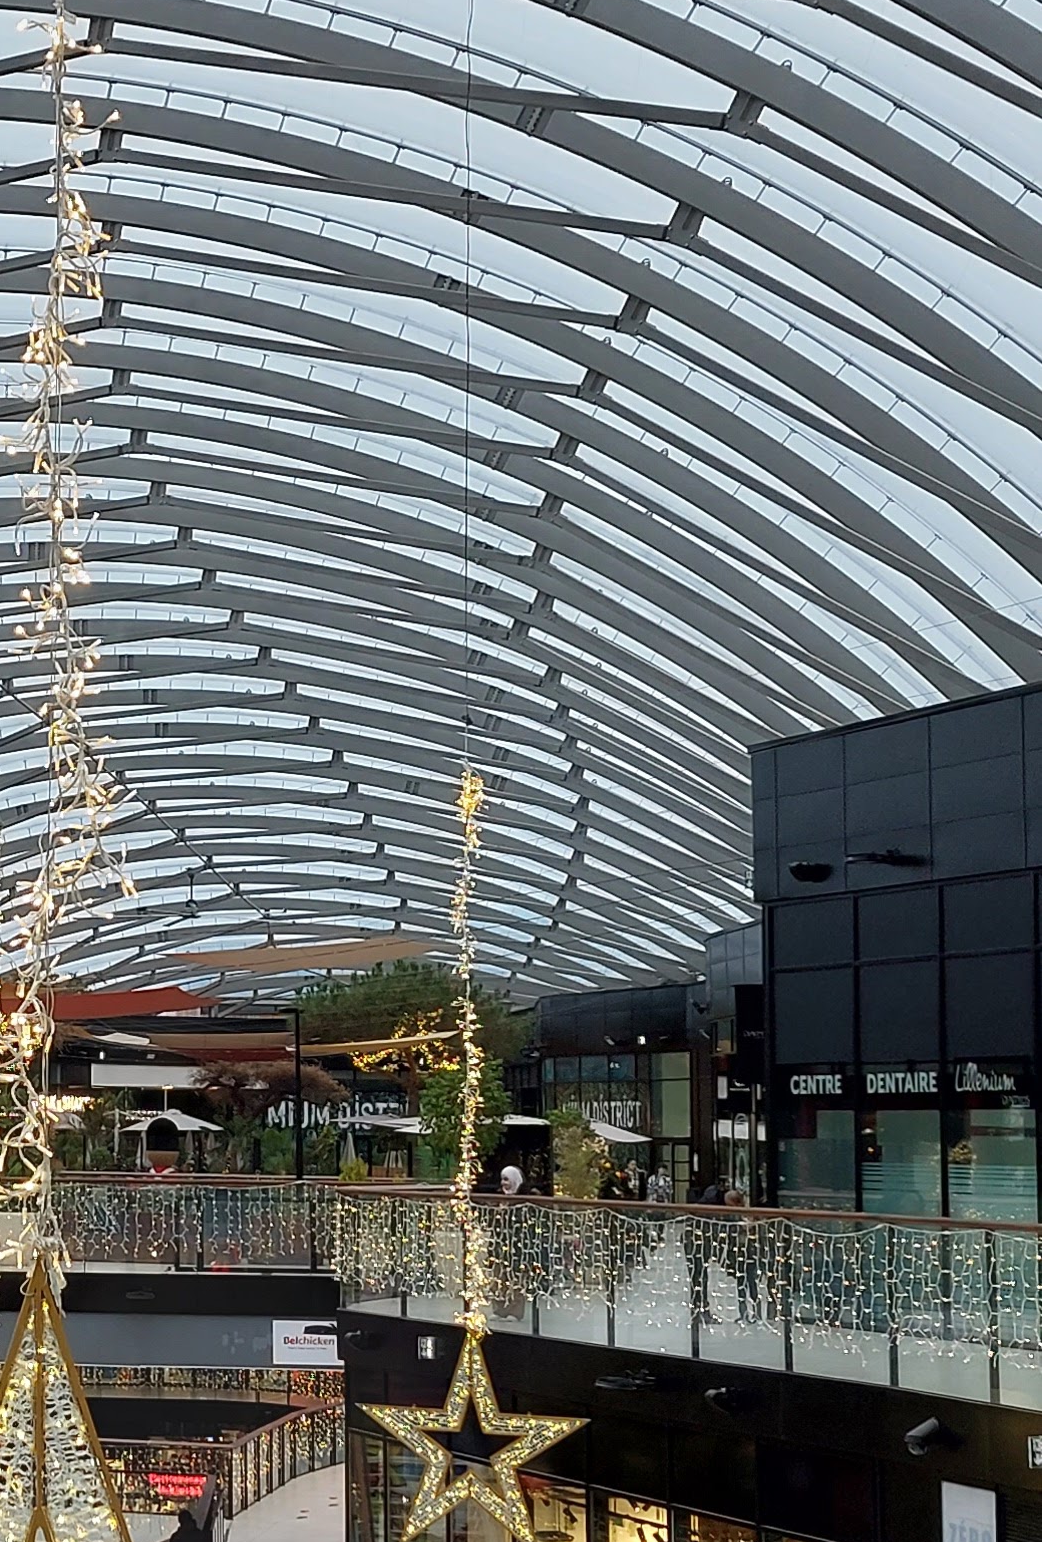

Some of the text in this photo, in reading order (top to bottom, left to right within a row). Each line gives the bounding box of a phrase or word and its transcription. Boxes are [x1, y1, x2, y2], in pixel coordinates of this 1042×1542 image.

[790, 1074, 842, 1095] CENTRE
[866, 1071, 938, 1094] DENTAIRE
[283, 1335, 335, 1346] Belchicken
